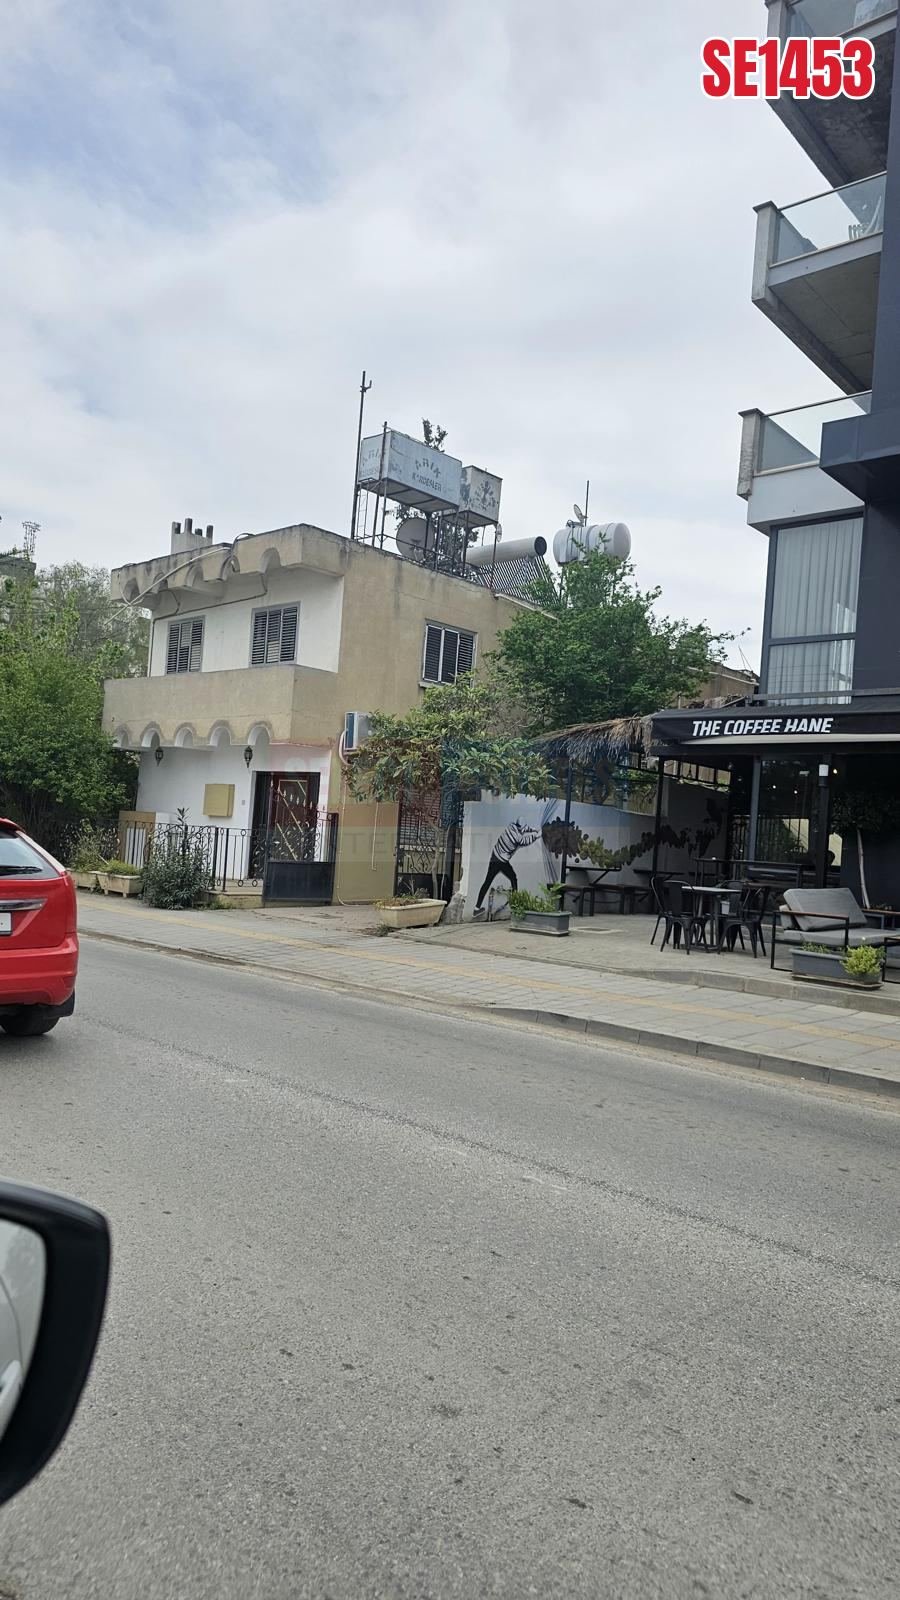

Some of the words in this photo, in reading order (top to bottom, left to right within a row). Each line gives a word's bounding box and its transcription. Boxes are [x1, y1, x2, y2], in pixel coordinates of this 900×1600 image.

[692, 720, 722, 737] THE
[723, 718, 782, 735] COFFEE
[783, 717, 834, 734] HANE
